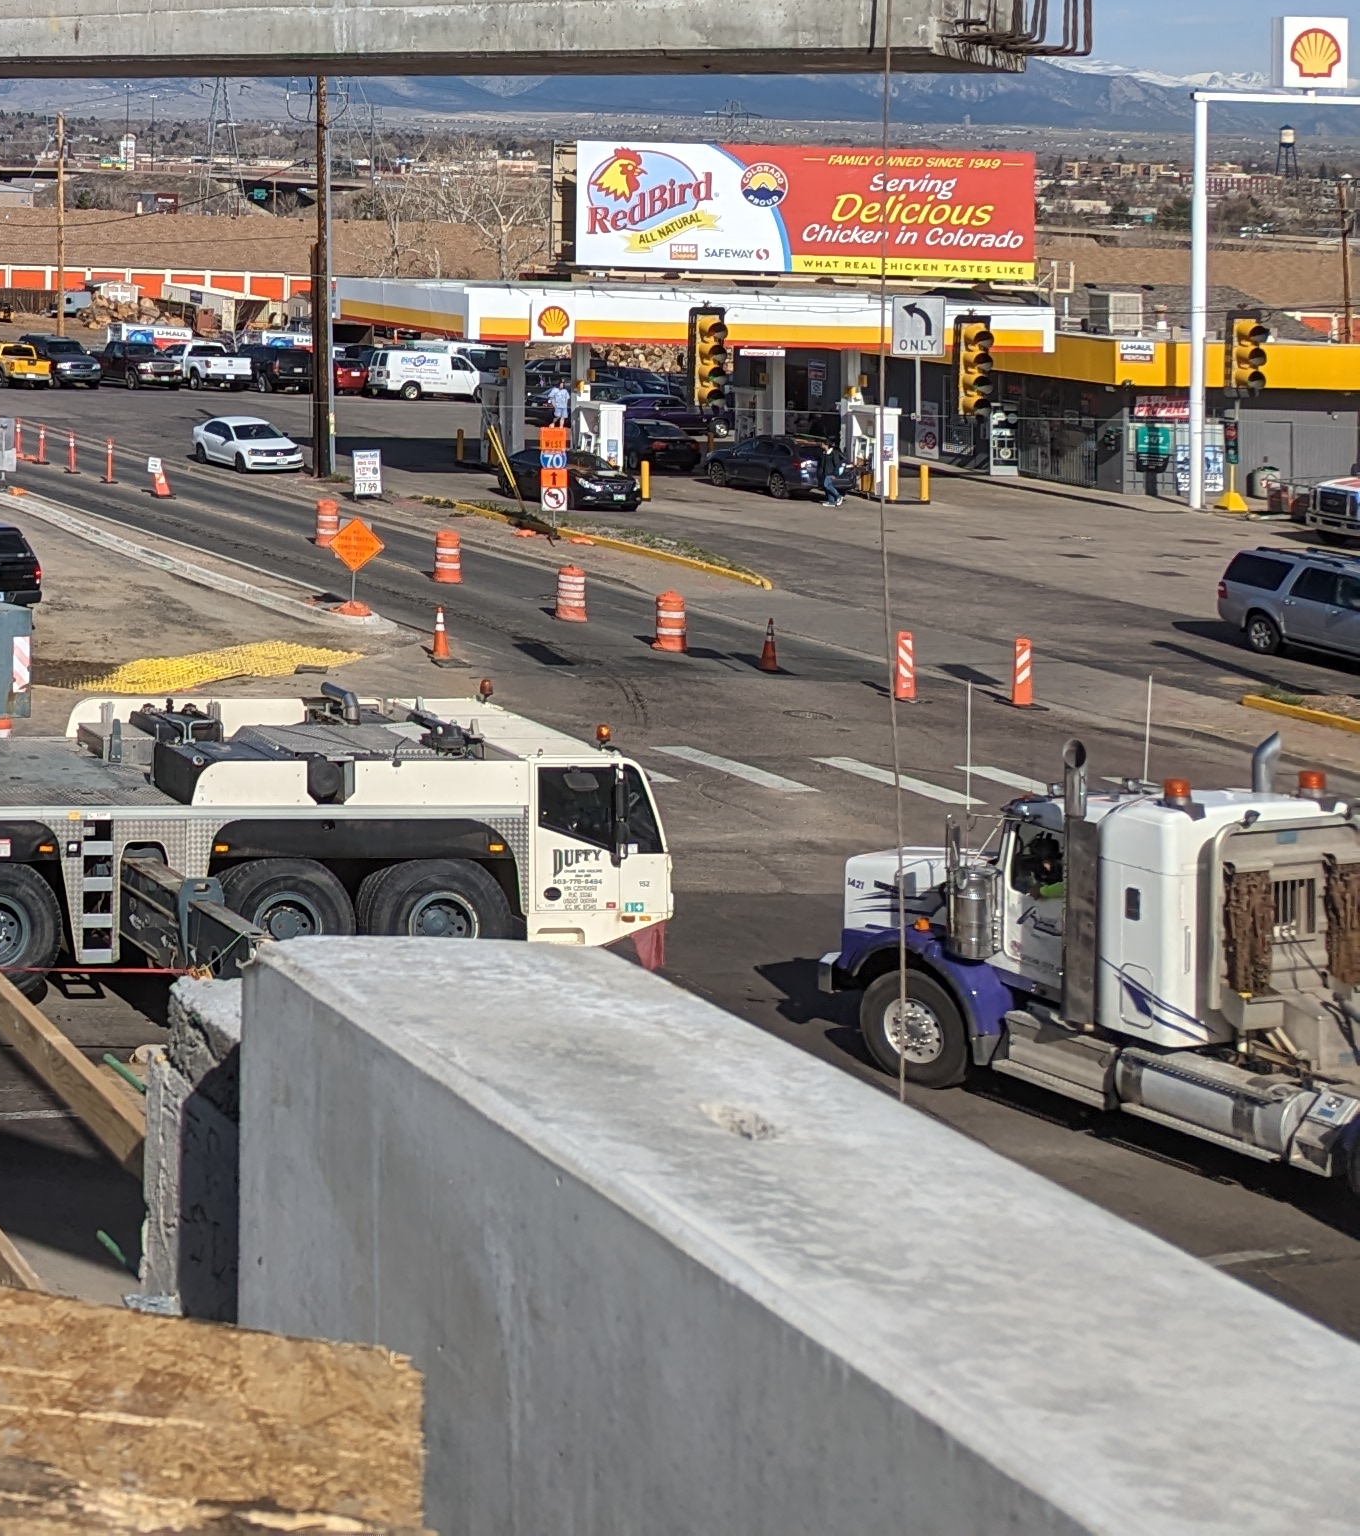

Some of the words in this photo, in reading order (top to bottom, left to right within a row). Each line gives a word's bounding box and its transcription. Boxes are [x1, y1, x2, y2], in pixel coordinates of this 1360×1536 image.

[828, 154, 874, 166] FAMILY
[925, 157, 964, 168] SINCE
[968, 158, 1001, 169] 1949
[742, 165, 784, 184] COLORADO
[869, 173, 958, 200] Serving
[586, 171, 714, 235] RedBird
[747, 194, 779, 206] PROUD
[831, 193, 995, 226] Delicious
[638, 232, 658, 245] ALL
[657, 212, 703, 239] NATURAL
[801, 223, 889, 244] Chicken
[895, 226, 919, 245] in
[925, 227, 1024, 249] Colorado
[704, 248, 755, 258] SAFEWAY
[803, 259, 840, 269] WHAT
[844, 261, 877, 270] REAL
[883, 262, 939, 272] CHICKEN
[944, 263, 992, 274] TASTES
[996, 266, 1025, 275] LIKE
[156, 330, 188, 338] U-HAUL
[899, 339, 937, 352] ONLY
[1120, 343, 1153, 352] U-HAUL
[543, 454, 563, 469] 70
[552, 849, 602, 878] DUFFY
[847, 877, 865, 890] 1421
